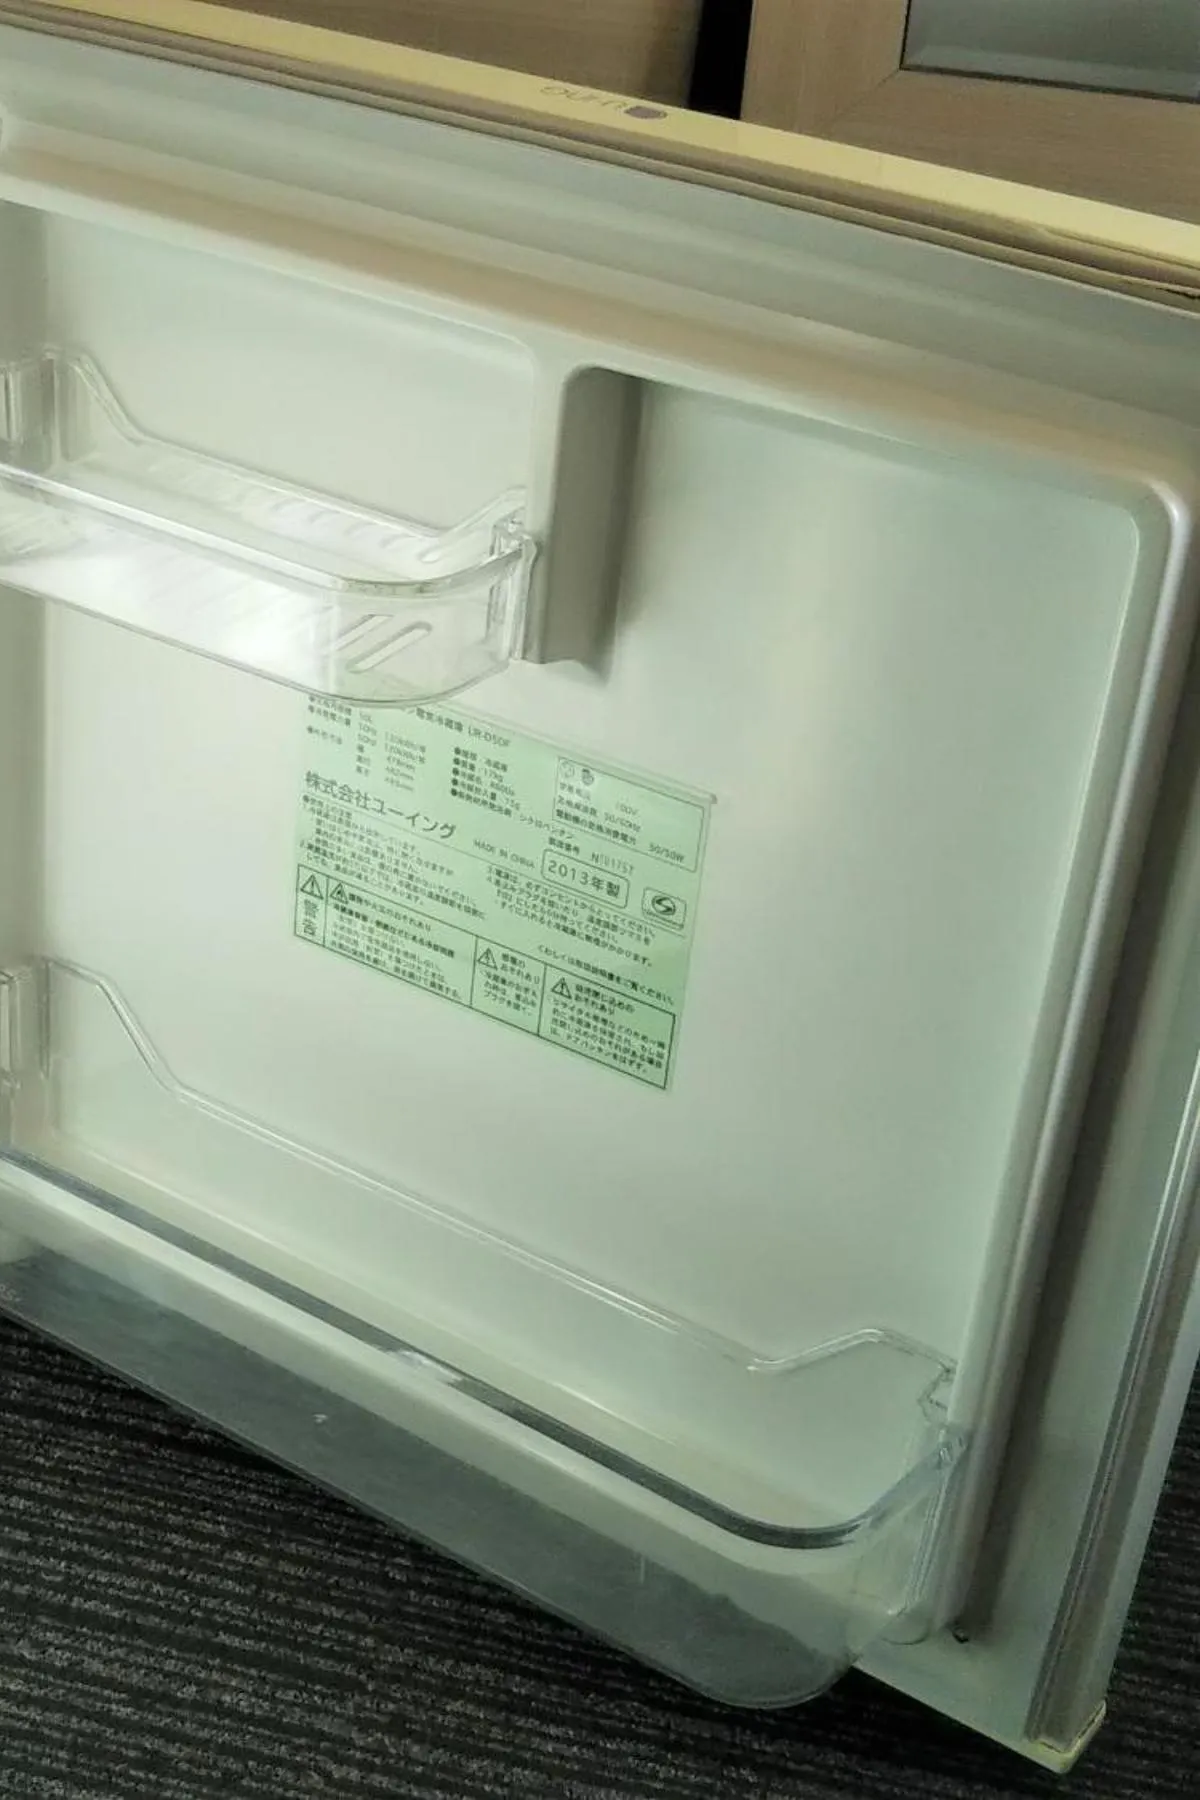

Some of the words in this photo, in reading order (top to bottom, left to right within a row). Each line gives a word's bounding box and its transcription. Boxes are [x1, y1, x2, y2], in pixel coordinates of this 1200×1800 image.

[305, 770, 457, 840] 株式会社ユーイング
[548, 859, 620, 899] 2013年製
